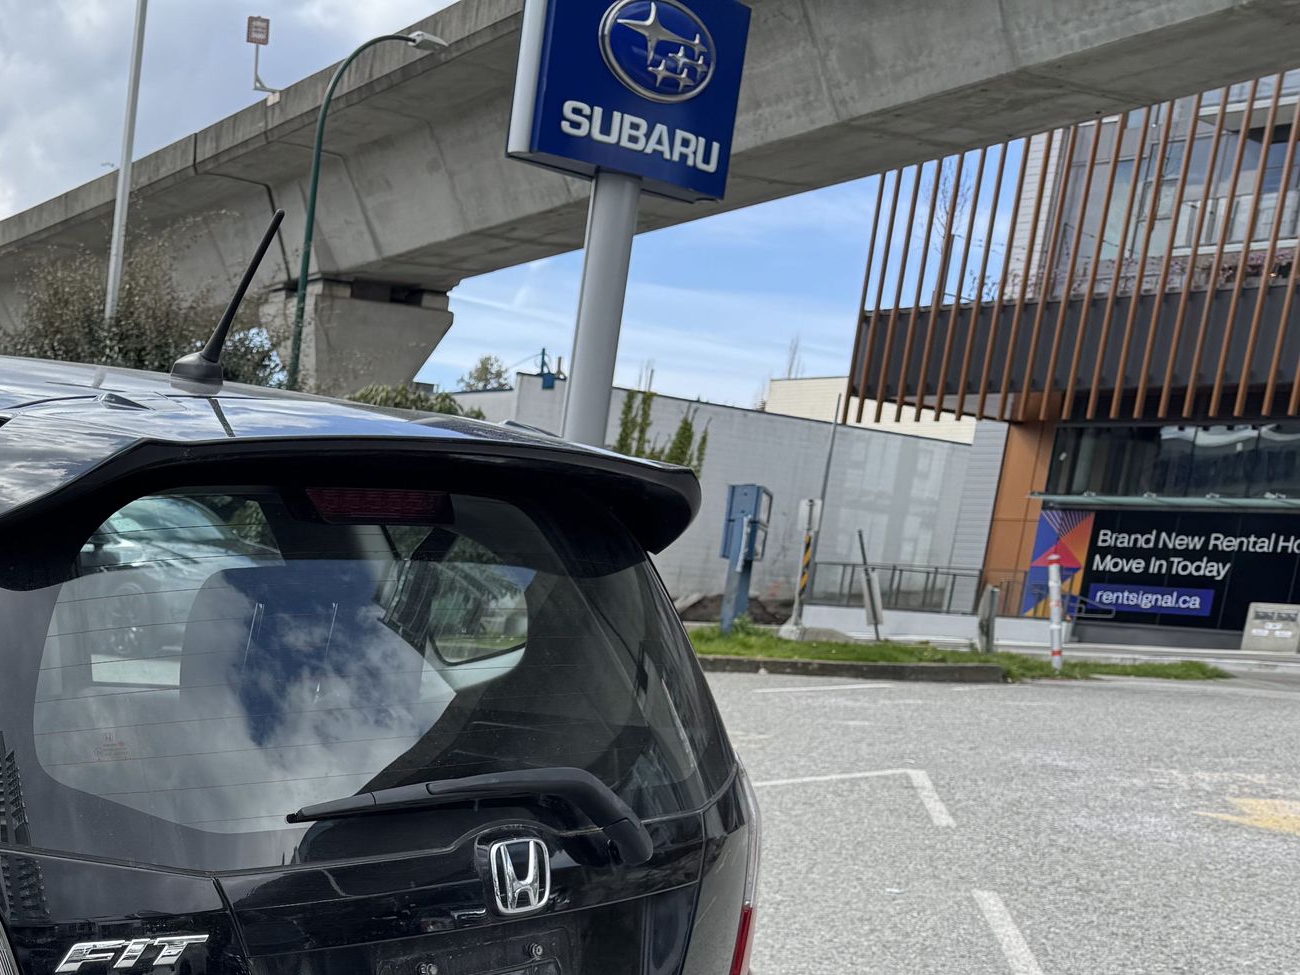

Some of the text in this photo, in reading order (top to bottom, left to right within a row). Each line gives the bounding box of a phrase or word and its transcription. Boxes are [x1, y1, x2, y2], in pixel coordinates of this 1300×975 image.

[561, 100, 720, 173] SUBARU
[1097, 530, 1156, 548] Brand
[1159, 532, 1205, 550] New
[1209, 533, 1276, 553] Rental
[1092, 554, 1231, 580] Move In Today
[1096, 590, 1200, 609] rentsignal.ca
[55, 934, 209, 973] FIT
